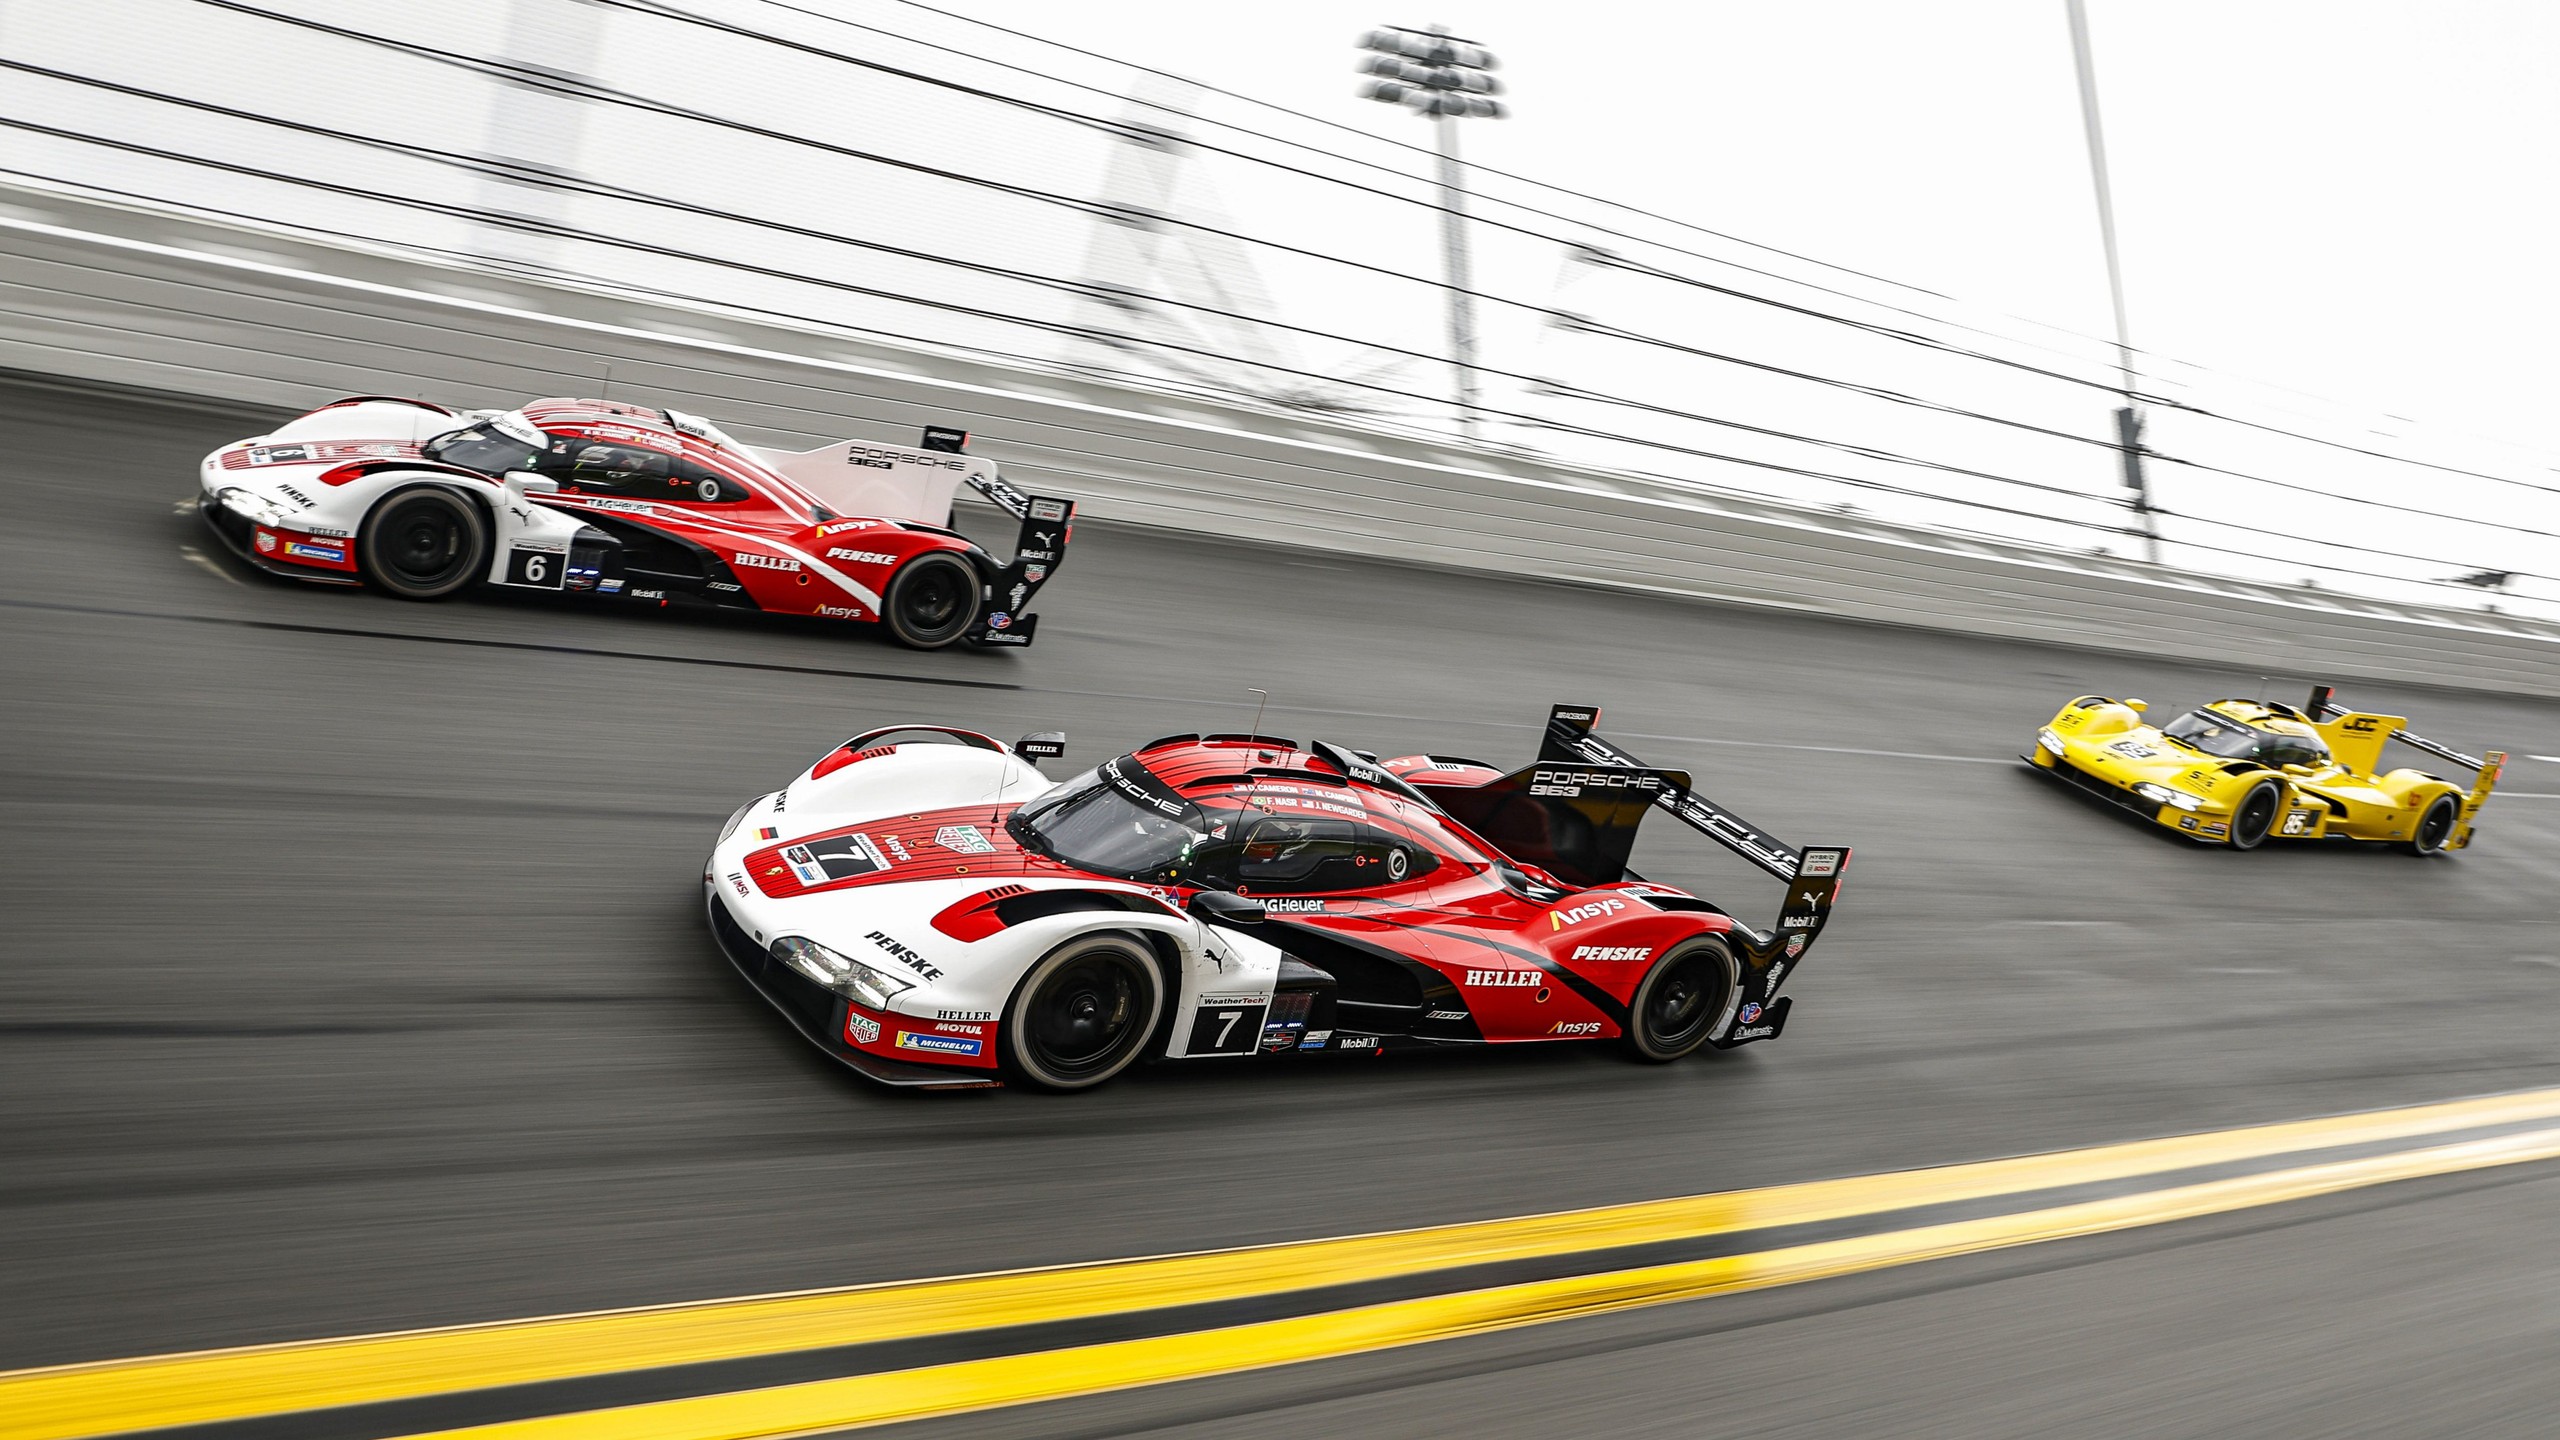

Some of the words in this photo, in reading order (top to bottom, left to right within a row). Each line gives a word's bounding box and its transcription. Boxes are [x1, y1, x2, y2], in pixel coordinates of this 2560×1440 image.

[849, 446, 965, 471] PORSCHE
[276, 484, 318, 510] PENSKE
[588, 498, 651, 513] TAGHeuer
[816, 520, 879, 538] Ansys
[734, 553, 801, 572] HELLER
[826, 547, 898, 565] PENSKE
[525, 556, 548, 582] 6
[813, 604, 862, 618] Ansys
[1026, 745, 1057, 753] HELLER
[1349, 767, 1373, 781] Mobil
[1533, 770, 1660, 790] PORSCHE
[1257, 784, 1298, 794] CAMERON
[1529, 785, 1581, 797] 963
[1266, 798, 1275, 806] F.
[1275, 797, 1298, 807] NASR
[1322, 803, 1367, 820] NEWGARDEN
[2283, 814, 2307, 834] 85
[940, 827, 975, 853] HEUER
[961, 826, 994, 851] TAG
[817, 845, 868, 861] 7
[857, 834, 887, 869] WeatherTech
[881, 834, 912, 862] Ansys
[734, 879, 750, 898] IMSA
[1549, 898, 1626, 931] Ansys
[1783, 917, 1807, 927] Mobil
[864, 930, 944, 981] PENSKE
[1571, 946, 1652, 961] PENSKE
[1465, 970, 1543, 987] HELLER
[1204, 997, 1264, 1005] WeatherTech
[853, 1015, 877, 1032] TAG
[937, 1010, 992, 1020] HELLER
[850, 1023, 878, 1042] HEUER
[935, 1023, 982, 1035] MOTUL
[1215, 1012, 1242, 1048] 7
[1547, 1020, 1602, 1035] Ansys
[920, 1039, 974, 1051] MICHELIN
[1340, 1038, 1368, 1049] Mobil
